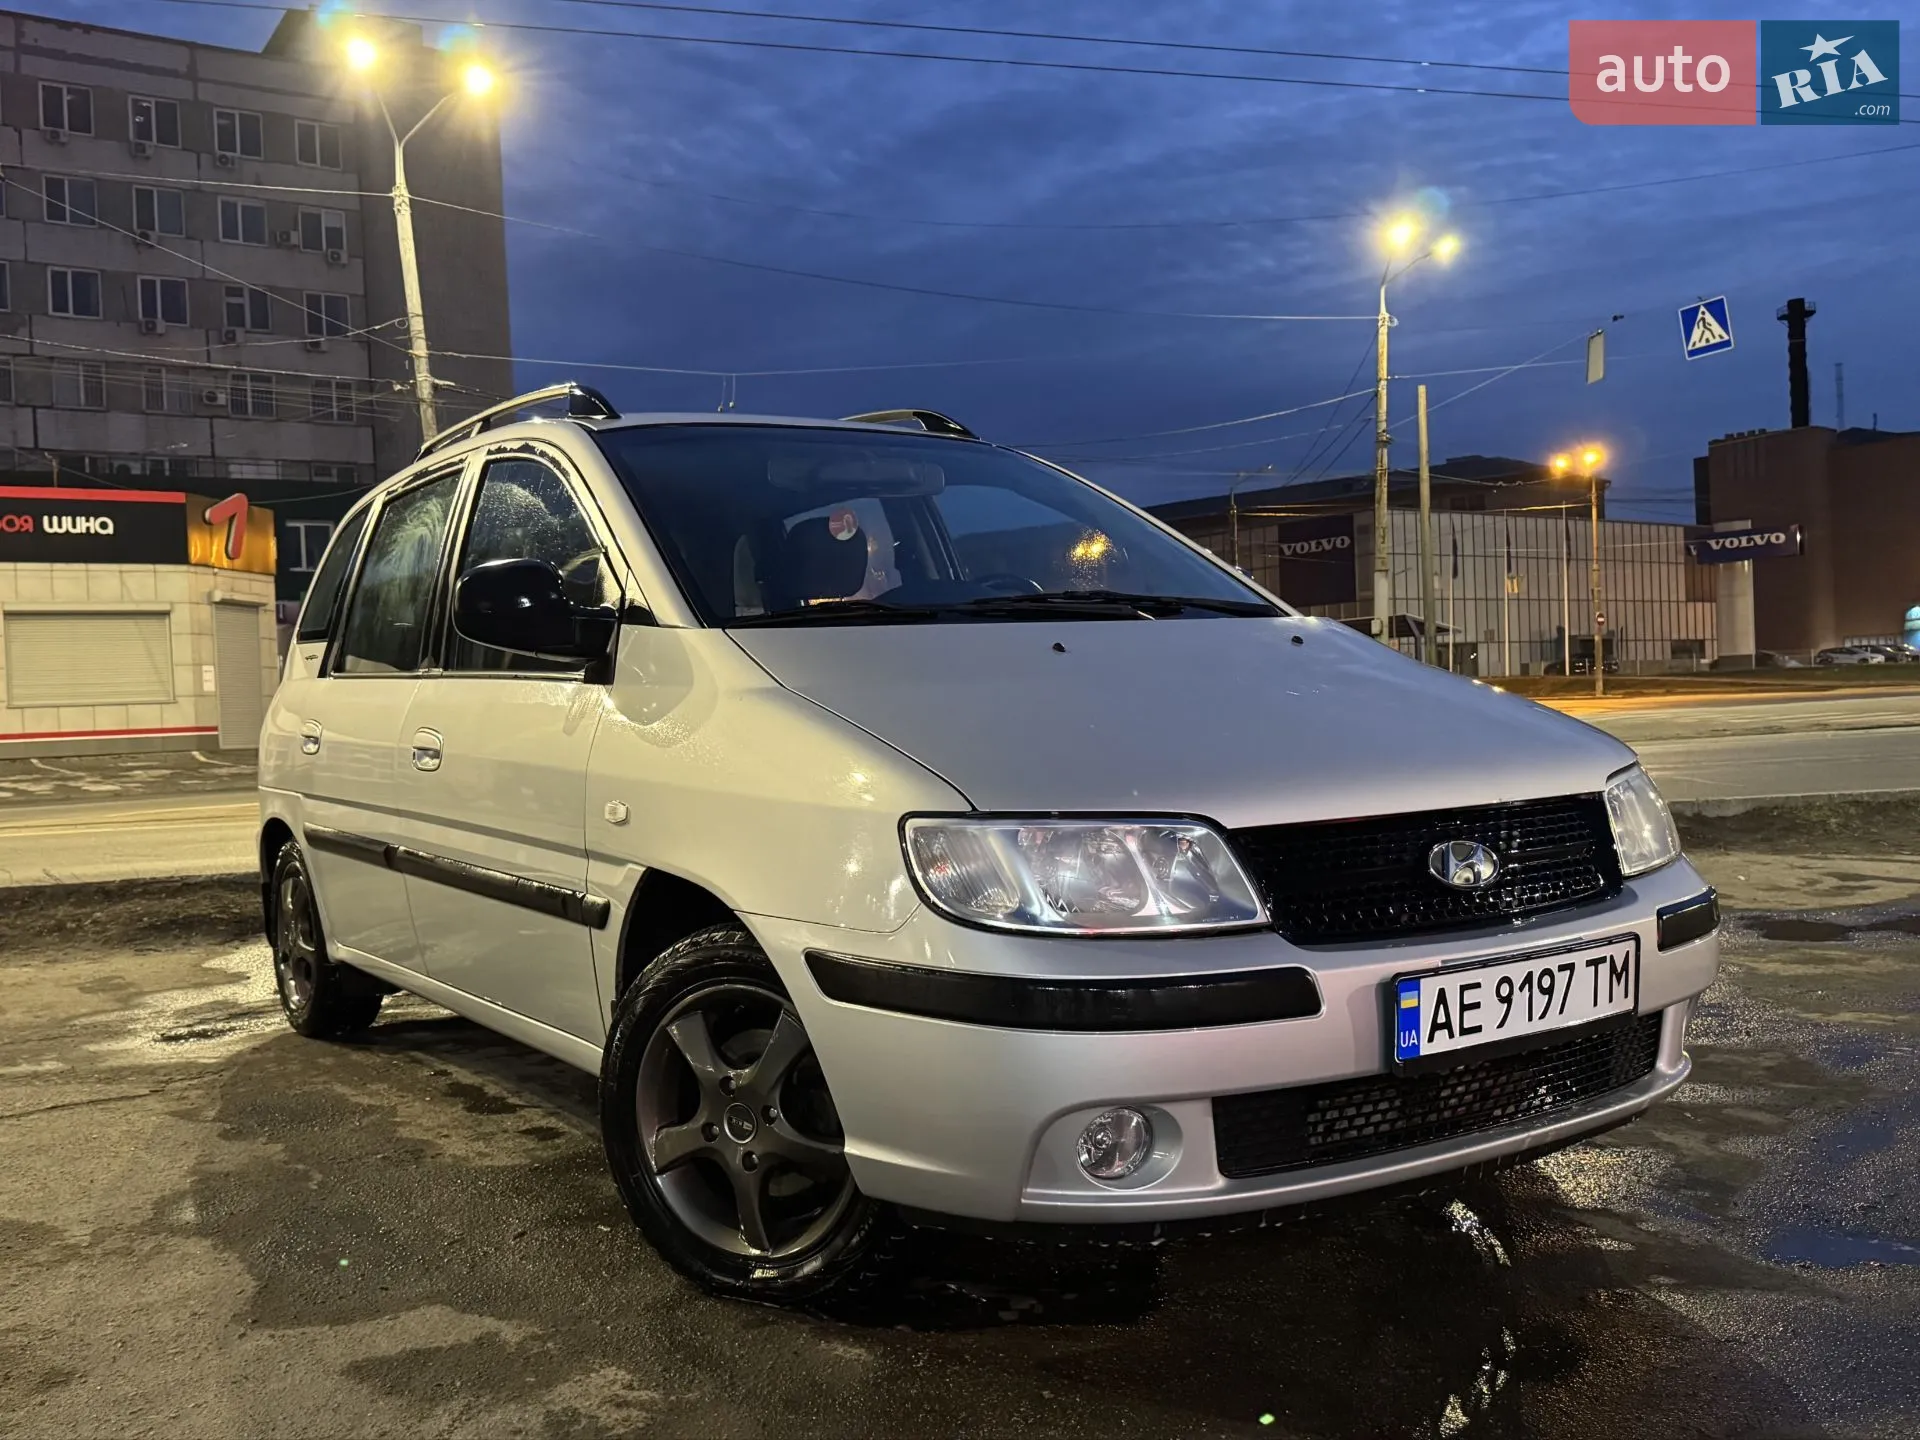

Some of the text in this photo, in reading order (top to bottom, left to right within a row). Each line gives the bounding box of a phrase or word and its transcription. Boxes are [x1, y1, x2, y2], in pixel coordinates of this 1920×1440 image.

[1280, 535, 1352, 556] VOLVO
[1706, 532, 1786, 550] VOLVO
[1427, 950, 1630, 1044] AE 9197 TM
[1400, 1029, 1419, 1049] UA
